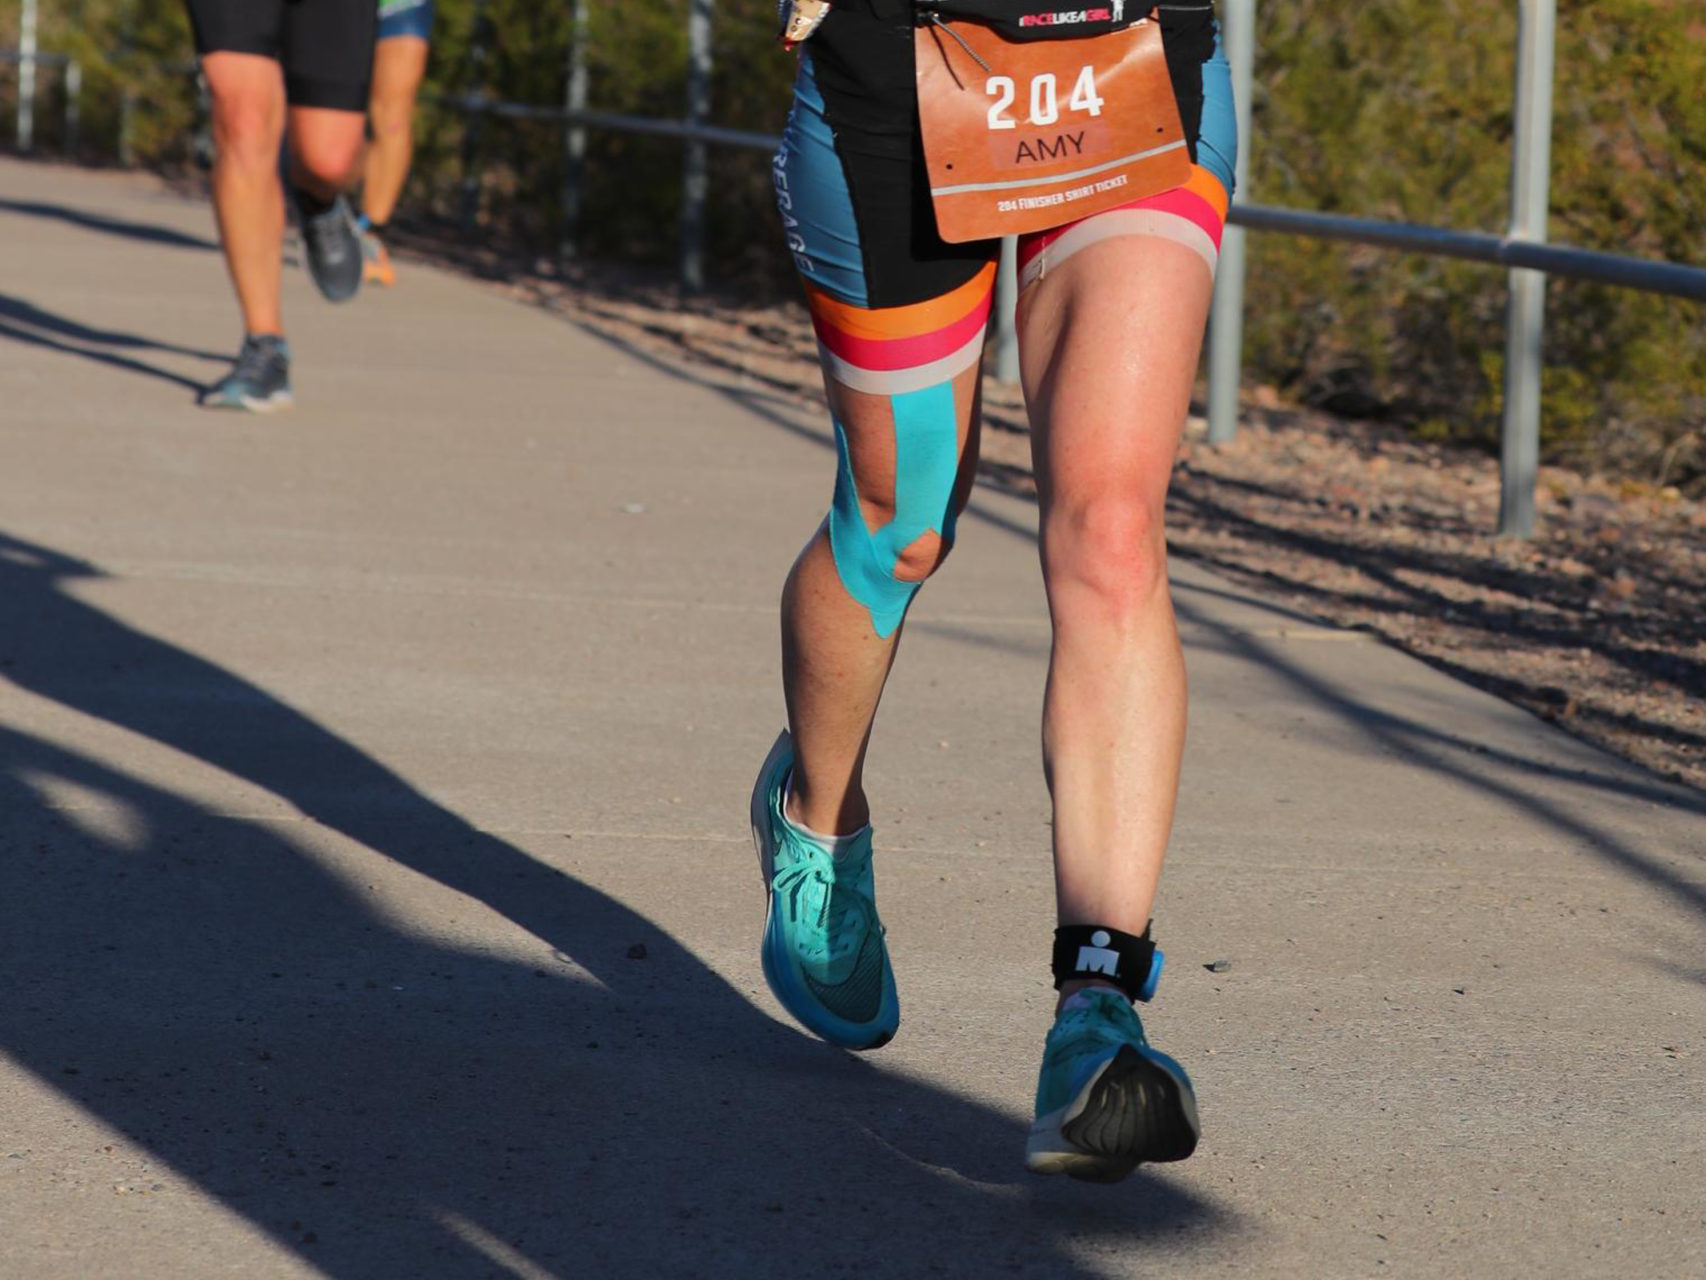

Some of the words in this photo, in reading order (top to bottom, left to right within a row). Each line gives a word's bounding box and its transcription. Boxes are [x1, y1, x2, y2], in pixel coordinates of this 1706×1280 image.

[985, 65, 1104, 130] 204
[1015, 131, 1085, 164] AMY
[1018, 192, 1065, 210] FINISHER
[1065, 184, 1095, 202] SHIRT
[1095, 174, 1129, 193] TICKET
